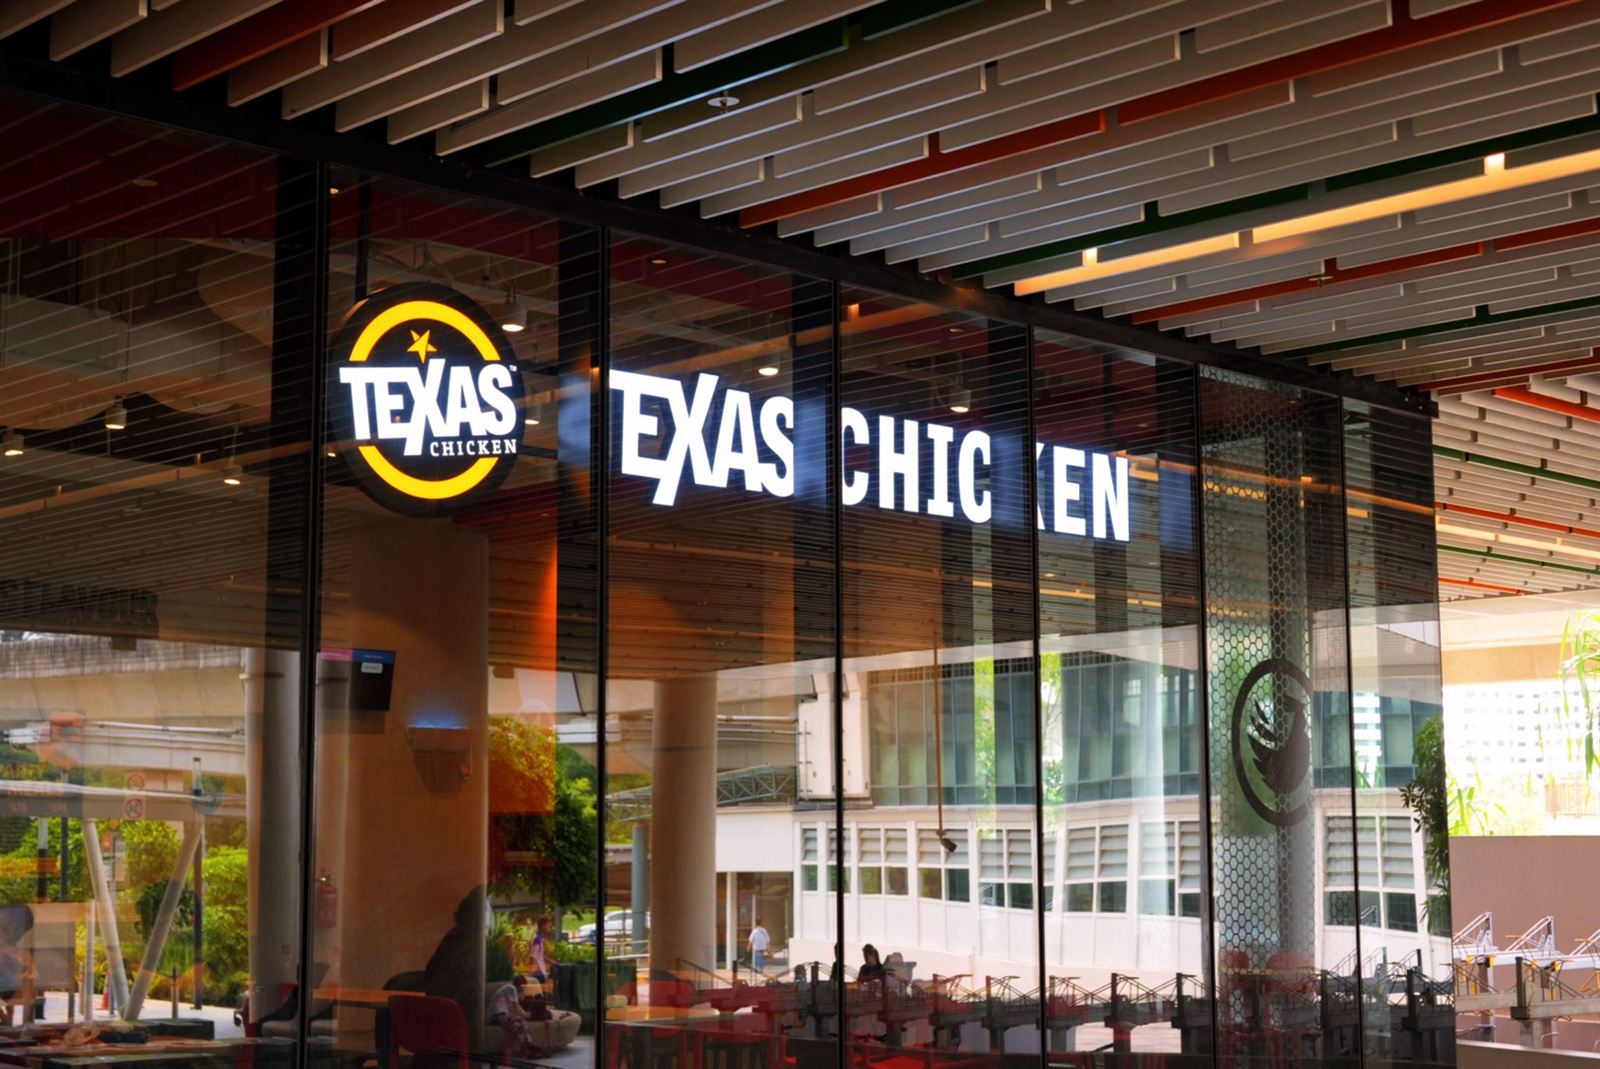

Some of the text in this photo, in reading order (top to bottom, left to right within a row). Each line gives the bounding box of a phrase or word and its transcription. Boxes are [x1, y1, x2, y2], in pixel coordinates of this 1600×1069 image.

[339, 358, 517, 456] TEXAS
[430, 439, 517, 457] CHICKEN
[609, 369, 1130, 542] EXAS CHICEN
